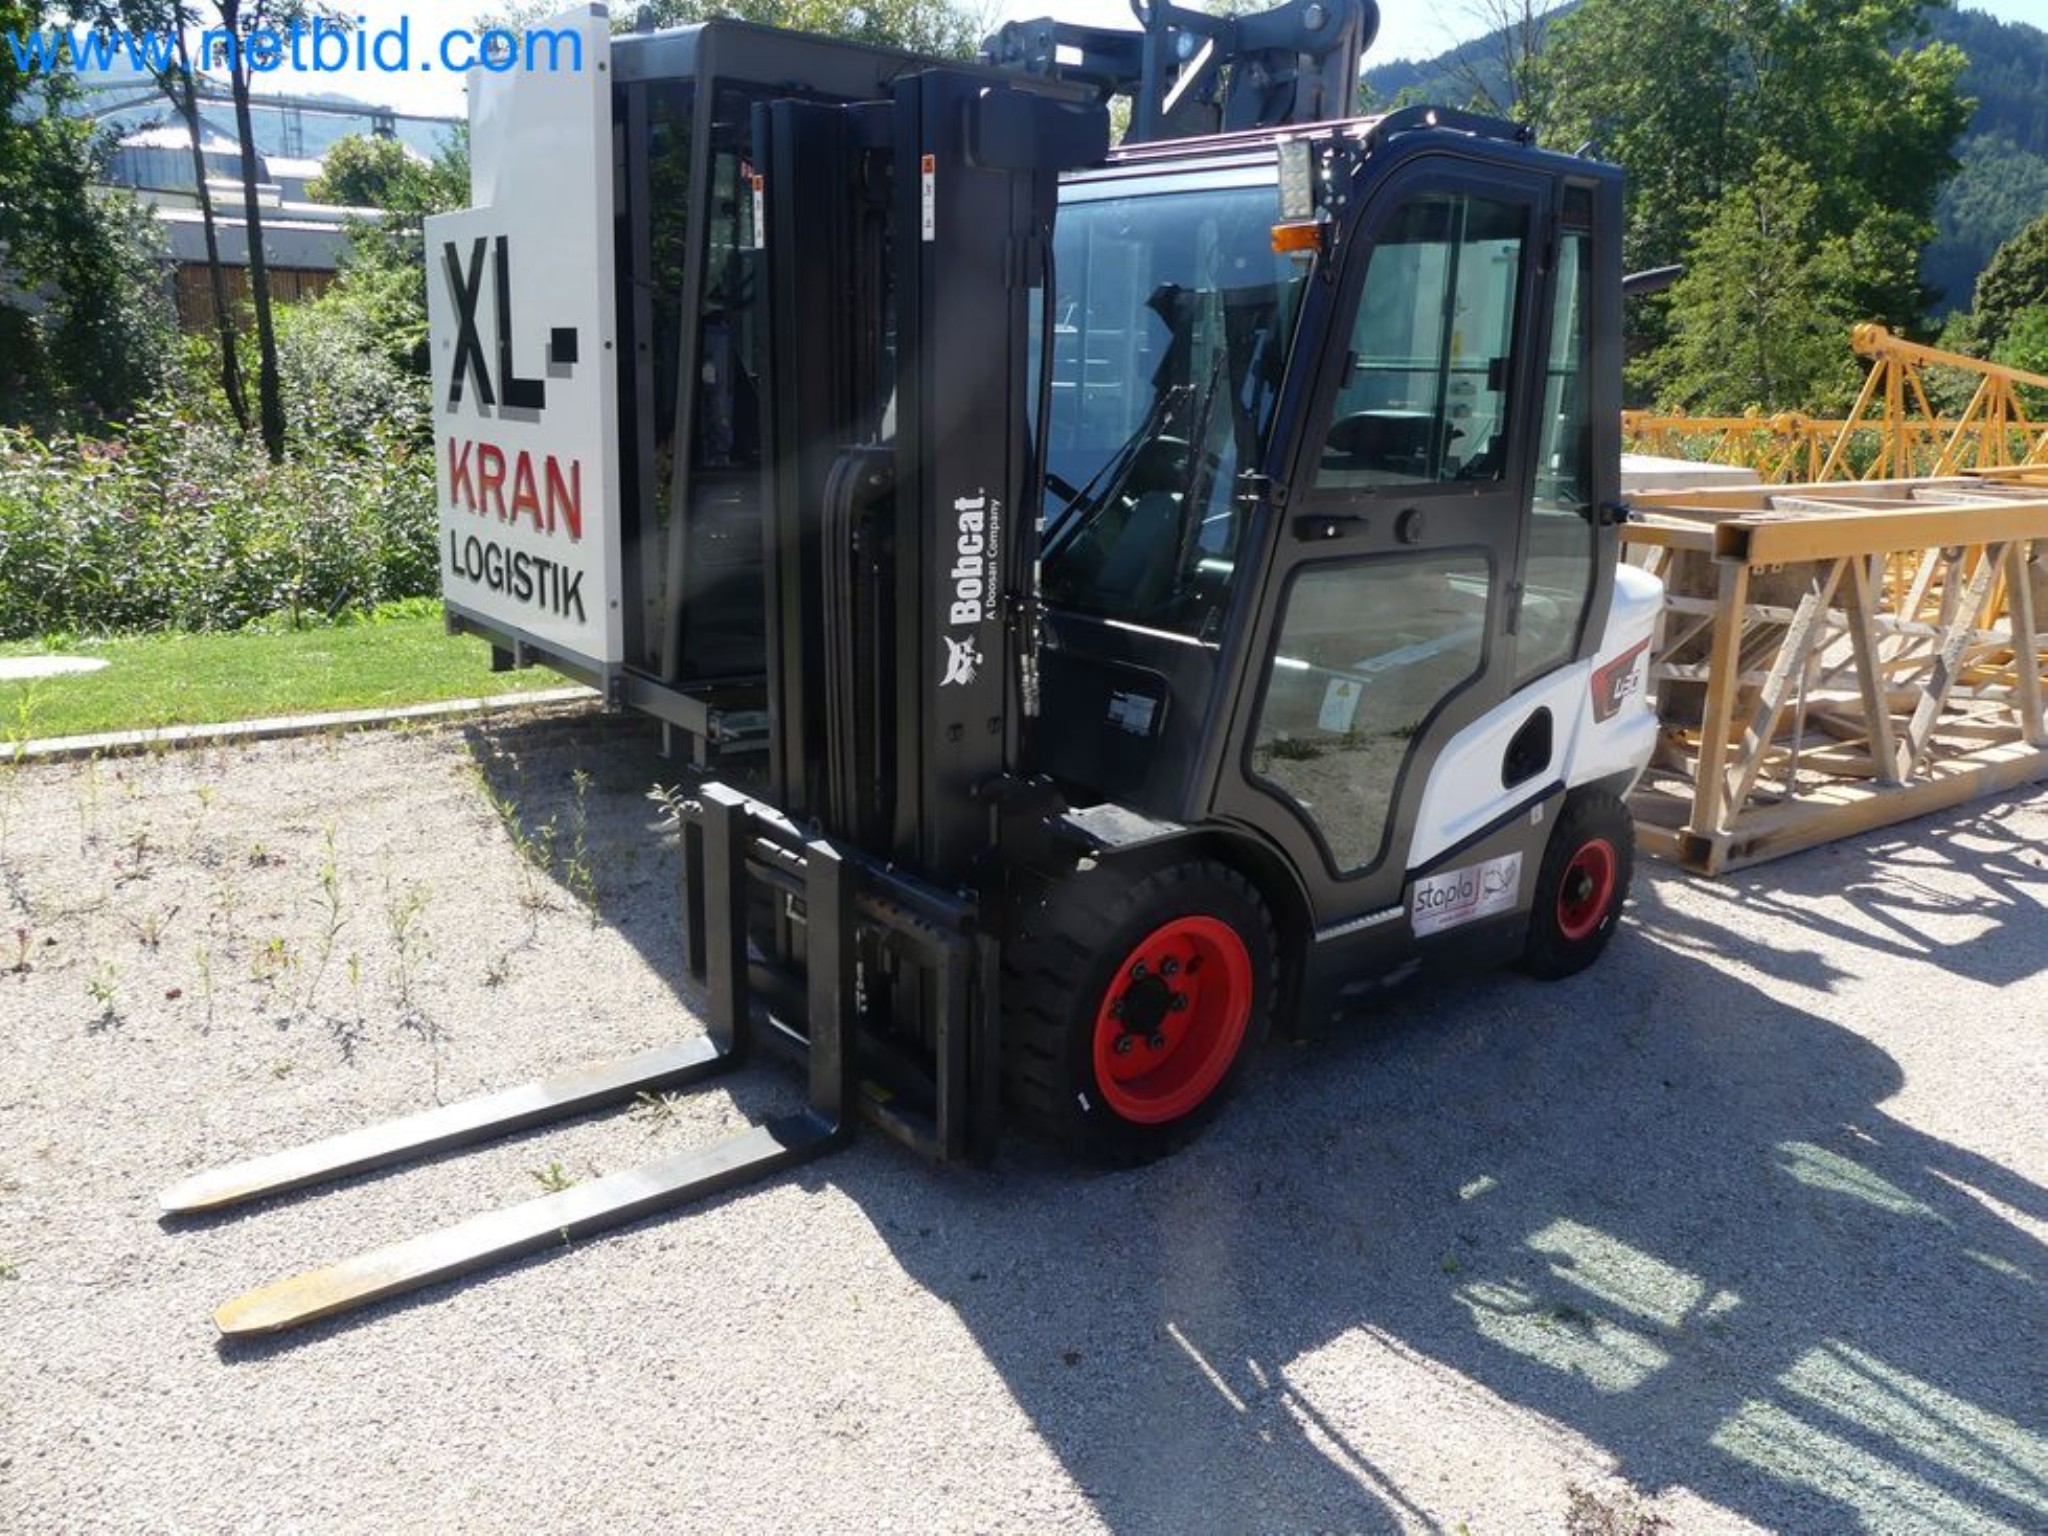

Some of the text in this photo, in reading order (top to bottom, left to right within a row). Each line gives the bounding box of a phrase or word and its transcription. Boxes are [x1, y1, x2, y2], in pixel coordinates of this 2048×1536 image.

[443, 234, 579, 412] XL-
[448, 436, 583, 541] KRAN
[450, 529, 587, 622] LOGISTIK
[949, 496, 986, 626] Bobcat
[985, 498, 1002, 620] A Doosan Company
